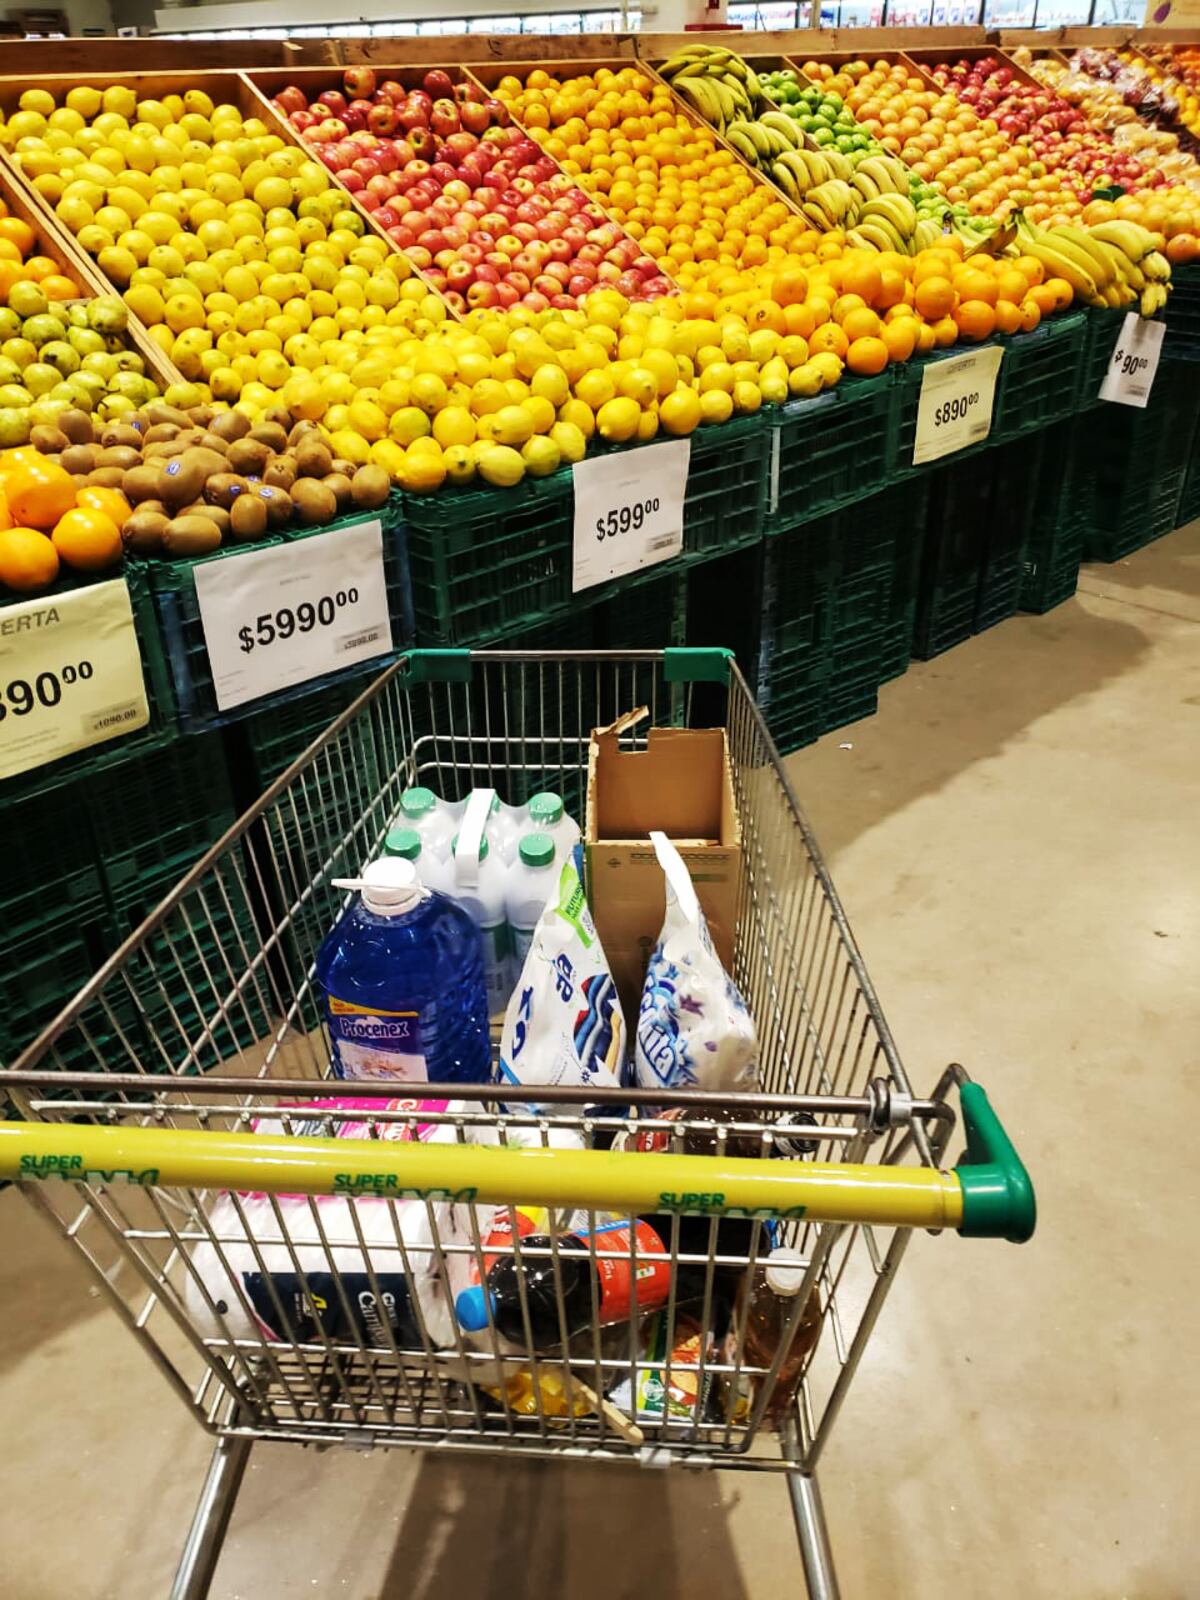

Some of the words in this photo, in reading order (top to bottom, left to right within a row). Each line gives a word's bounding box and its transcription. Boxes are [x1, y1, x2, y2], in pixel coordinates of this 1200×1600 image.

[340, 1018, 410, 1039] Procenex
[20, 1155, 83, 1170] SUPER
[334, 1173, 399, 1188] SUPER
[659, 1192, 726, 1207] SUPER
